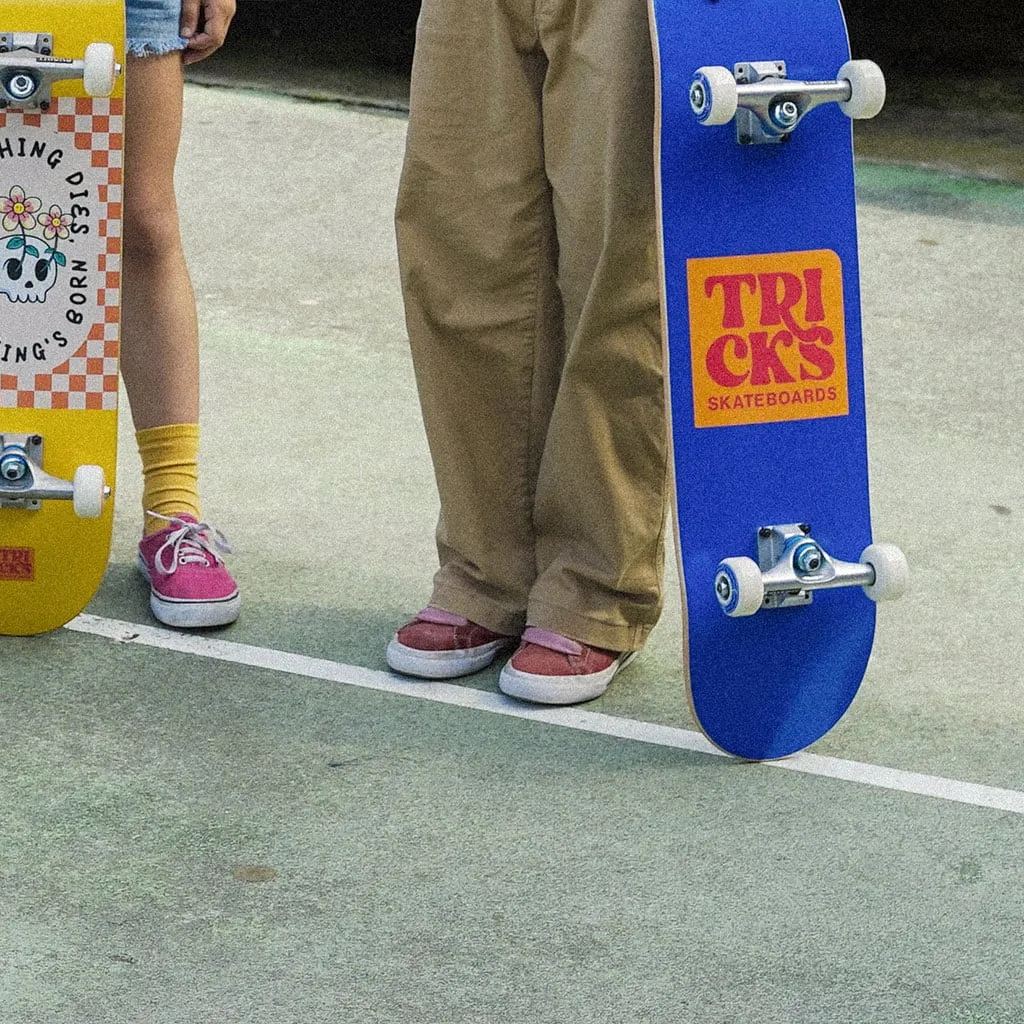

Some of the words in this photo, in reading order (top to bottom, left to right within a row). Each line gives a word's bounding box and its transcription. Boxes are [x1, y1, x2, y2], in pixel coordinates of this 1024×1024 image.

[65, 259, 88, 325] BORN
[704, 268, 834, 345] TRI
[705, 329, 835, 387] CKS
[707, 386, 837, 411] SKATEBOARDS
